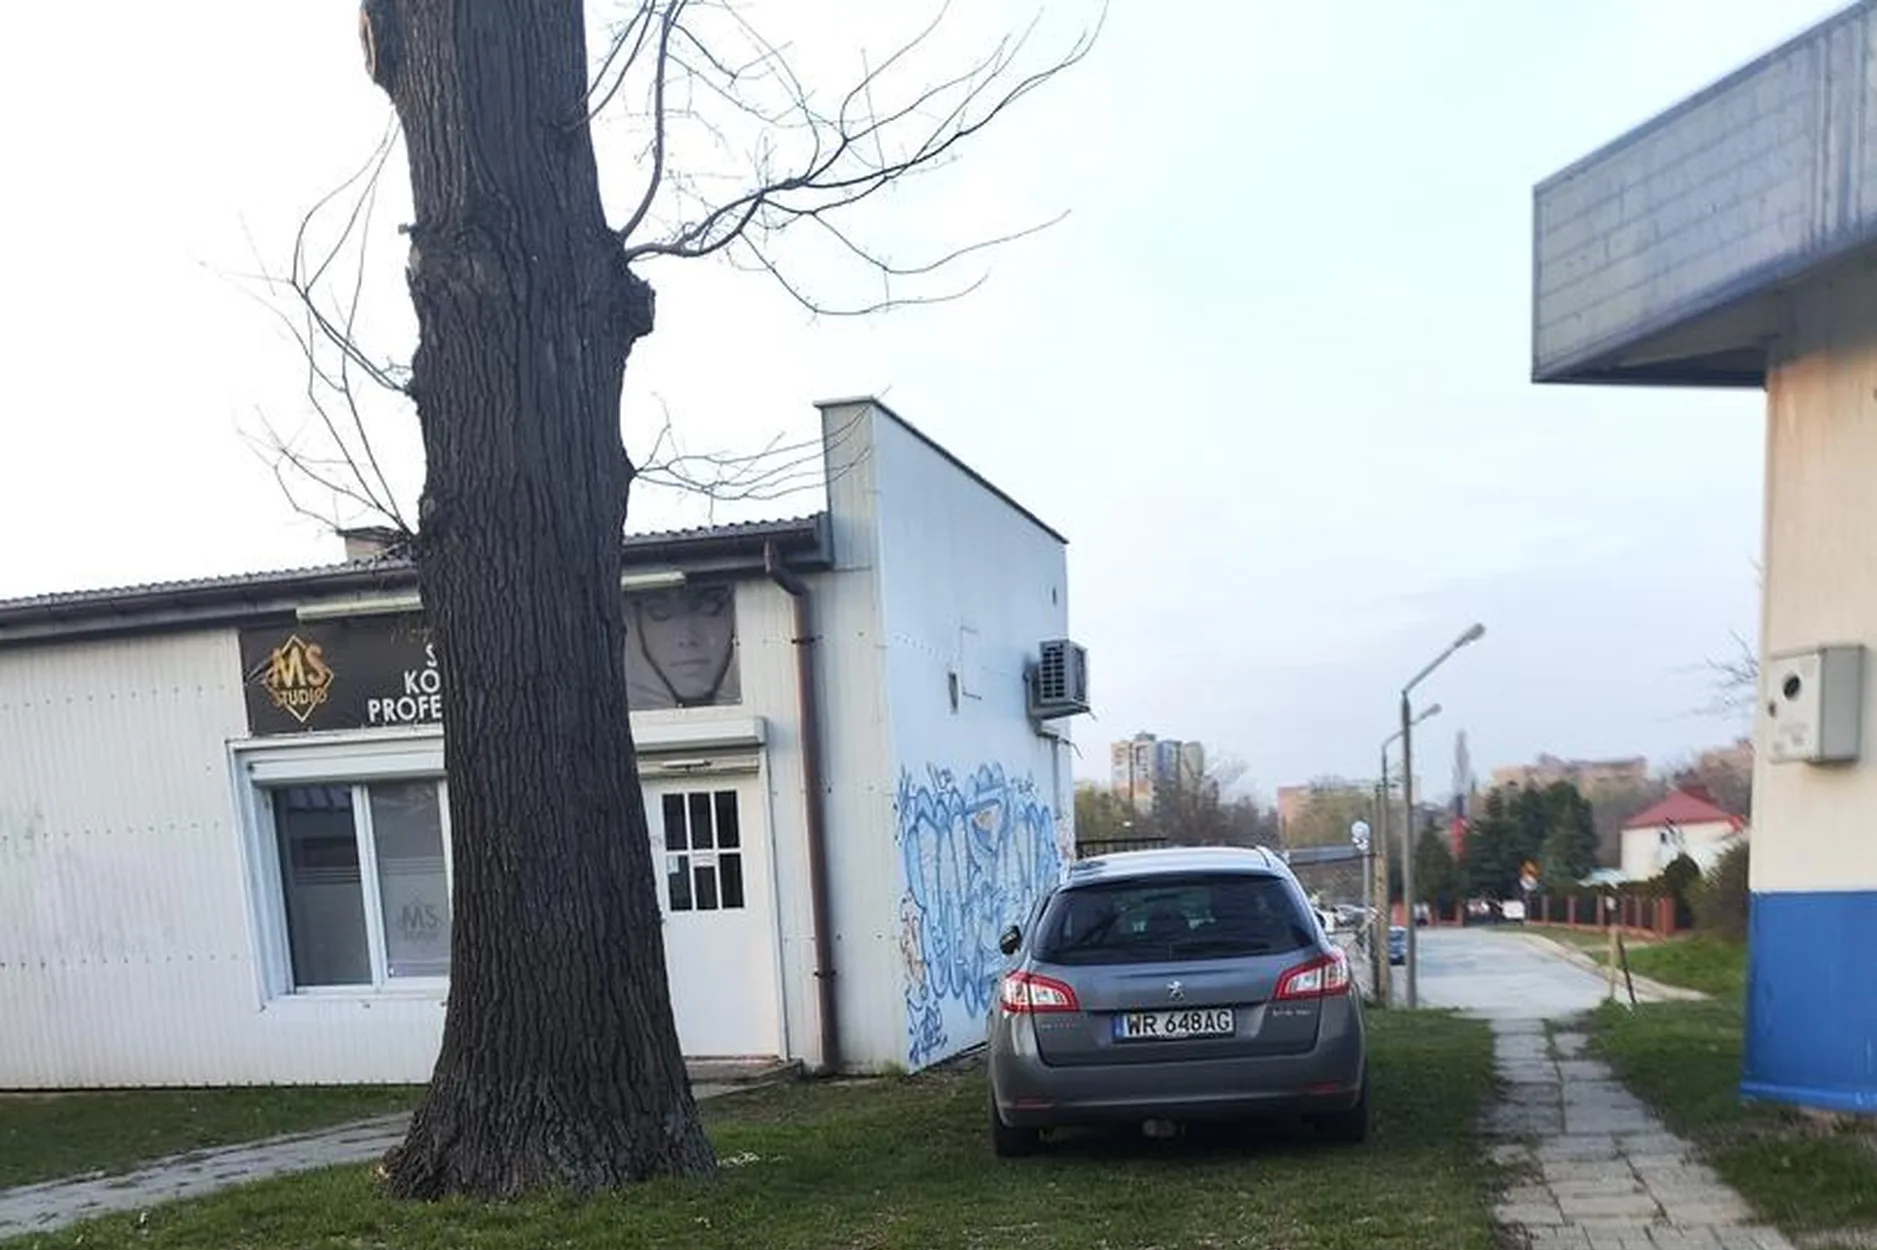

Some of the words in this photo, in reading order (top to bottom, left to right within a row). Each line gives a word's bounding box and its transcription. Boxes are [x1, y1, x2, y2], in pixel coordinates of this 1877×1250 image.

[272, 643, 327, 687] MS
[425, 643, 438, 667] S
[404, 669, 440, 694] KO
[273, 687, 328, 707] STUDIO
[367, 695, 443, 722] PROFE
[1128, 1015, 1157, 1035] WR
[1164, 1010, 1230, 1033] 648AG
